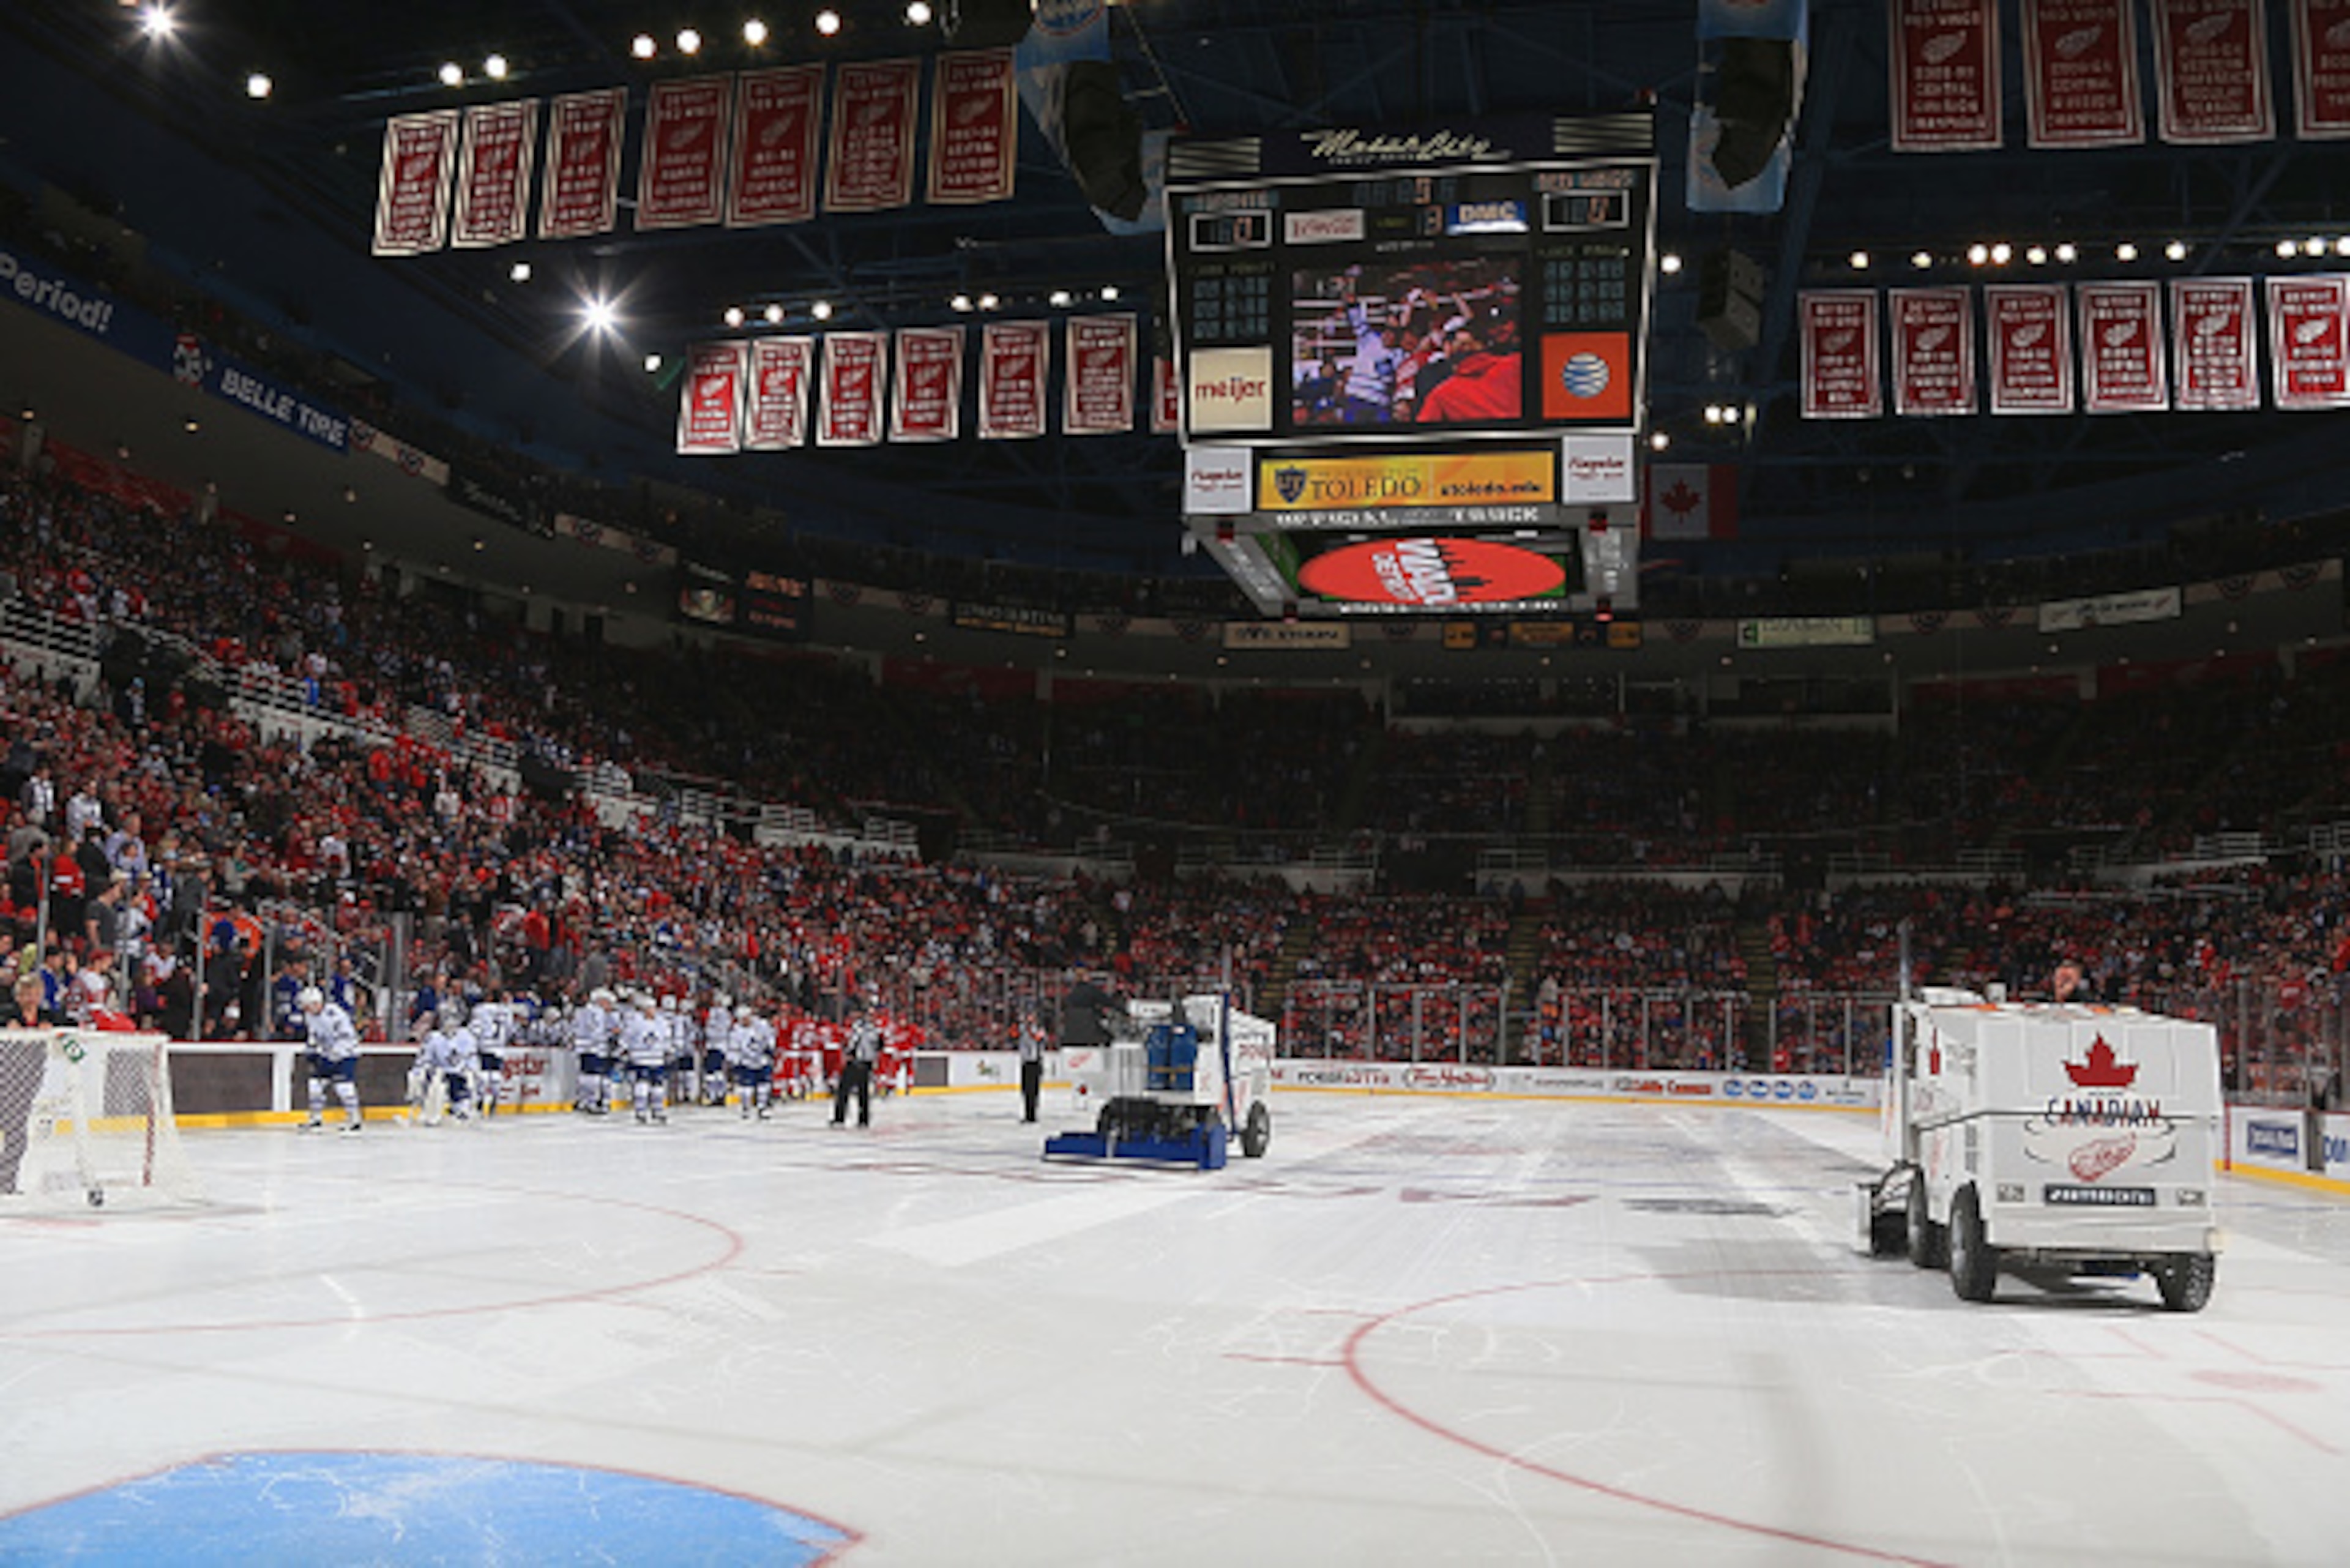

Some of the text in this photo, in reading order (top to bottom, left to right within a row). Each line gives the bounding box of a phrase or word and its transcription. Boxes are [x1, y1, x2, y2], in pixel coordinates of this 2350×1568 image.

[1195, 376, 1267, 405] meijer
[221, 367, 348, 447] BELLE TIRE
[1310, 476, 1422, 501] TOLEDO
[2045, 1099, 2160, 1129] CANADIAN
